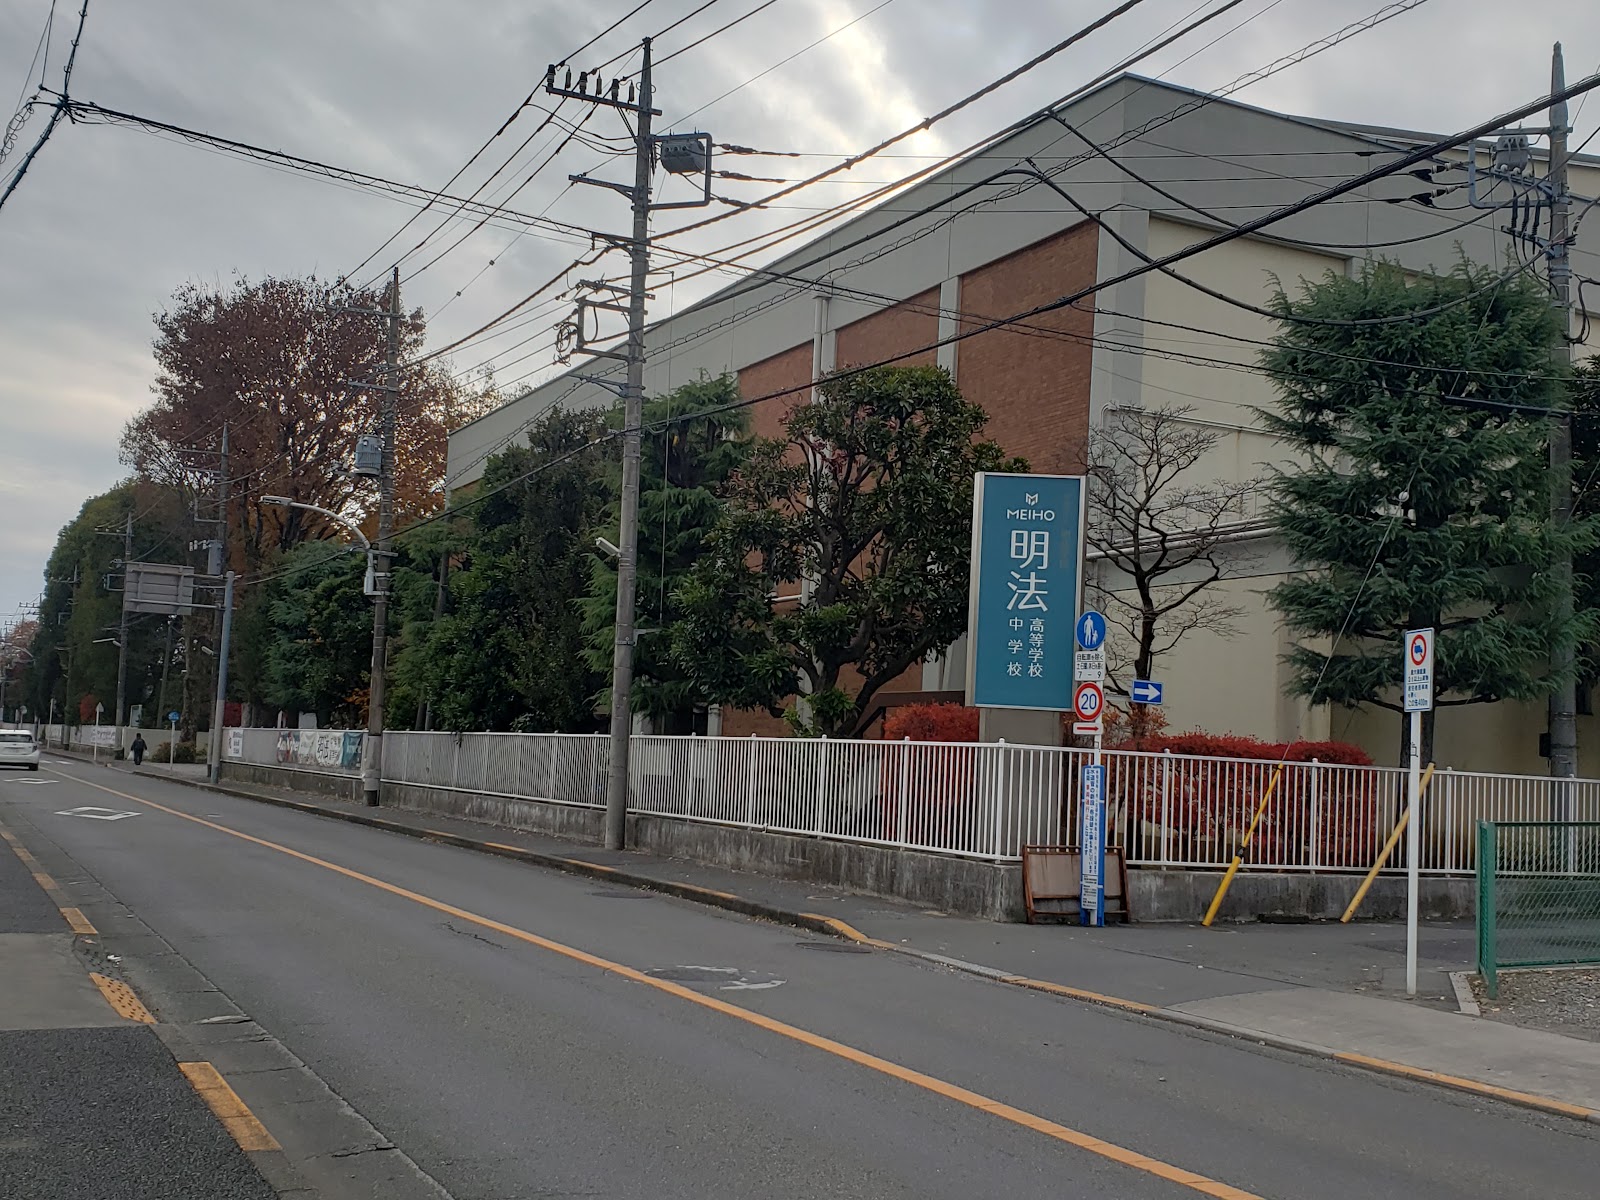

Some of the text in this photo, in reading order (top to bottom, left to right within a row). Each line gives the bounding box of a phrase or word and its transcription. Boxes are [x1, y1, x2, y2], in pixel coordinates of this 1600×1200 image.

[1006, 509, 1055, 522] MEIHO
[1006, 529, 1050, 612] 明法
[1006, 616, 1024, 677] 中学校
[1027, 617, 1045, 678] 高等学校
[1080, 693, 1097, 710] 20
